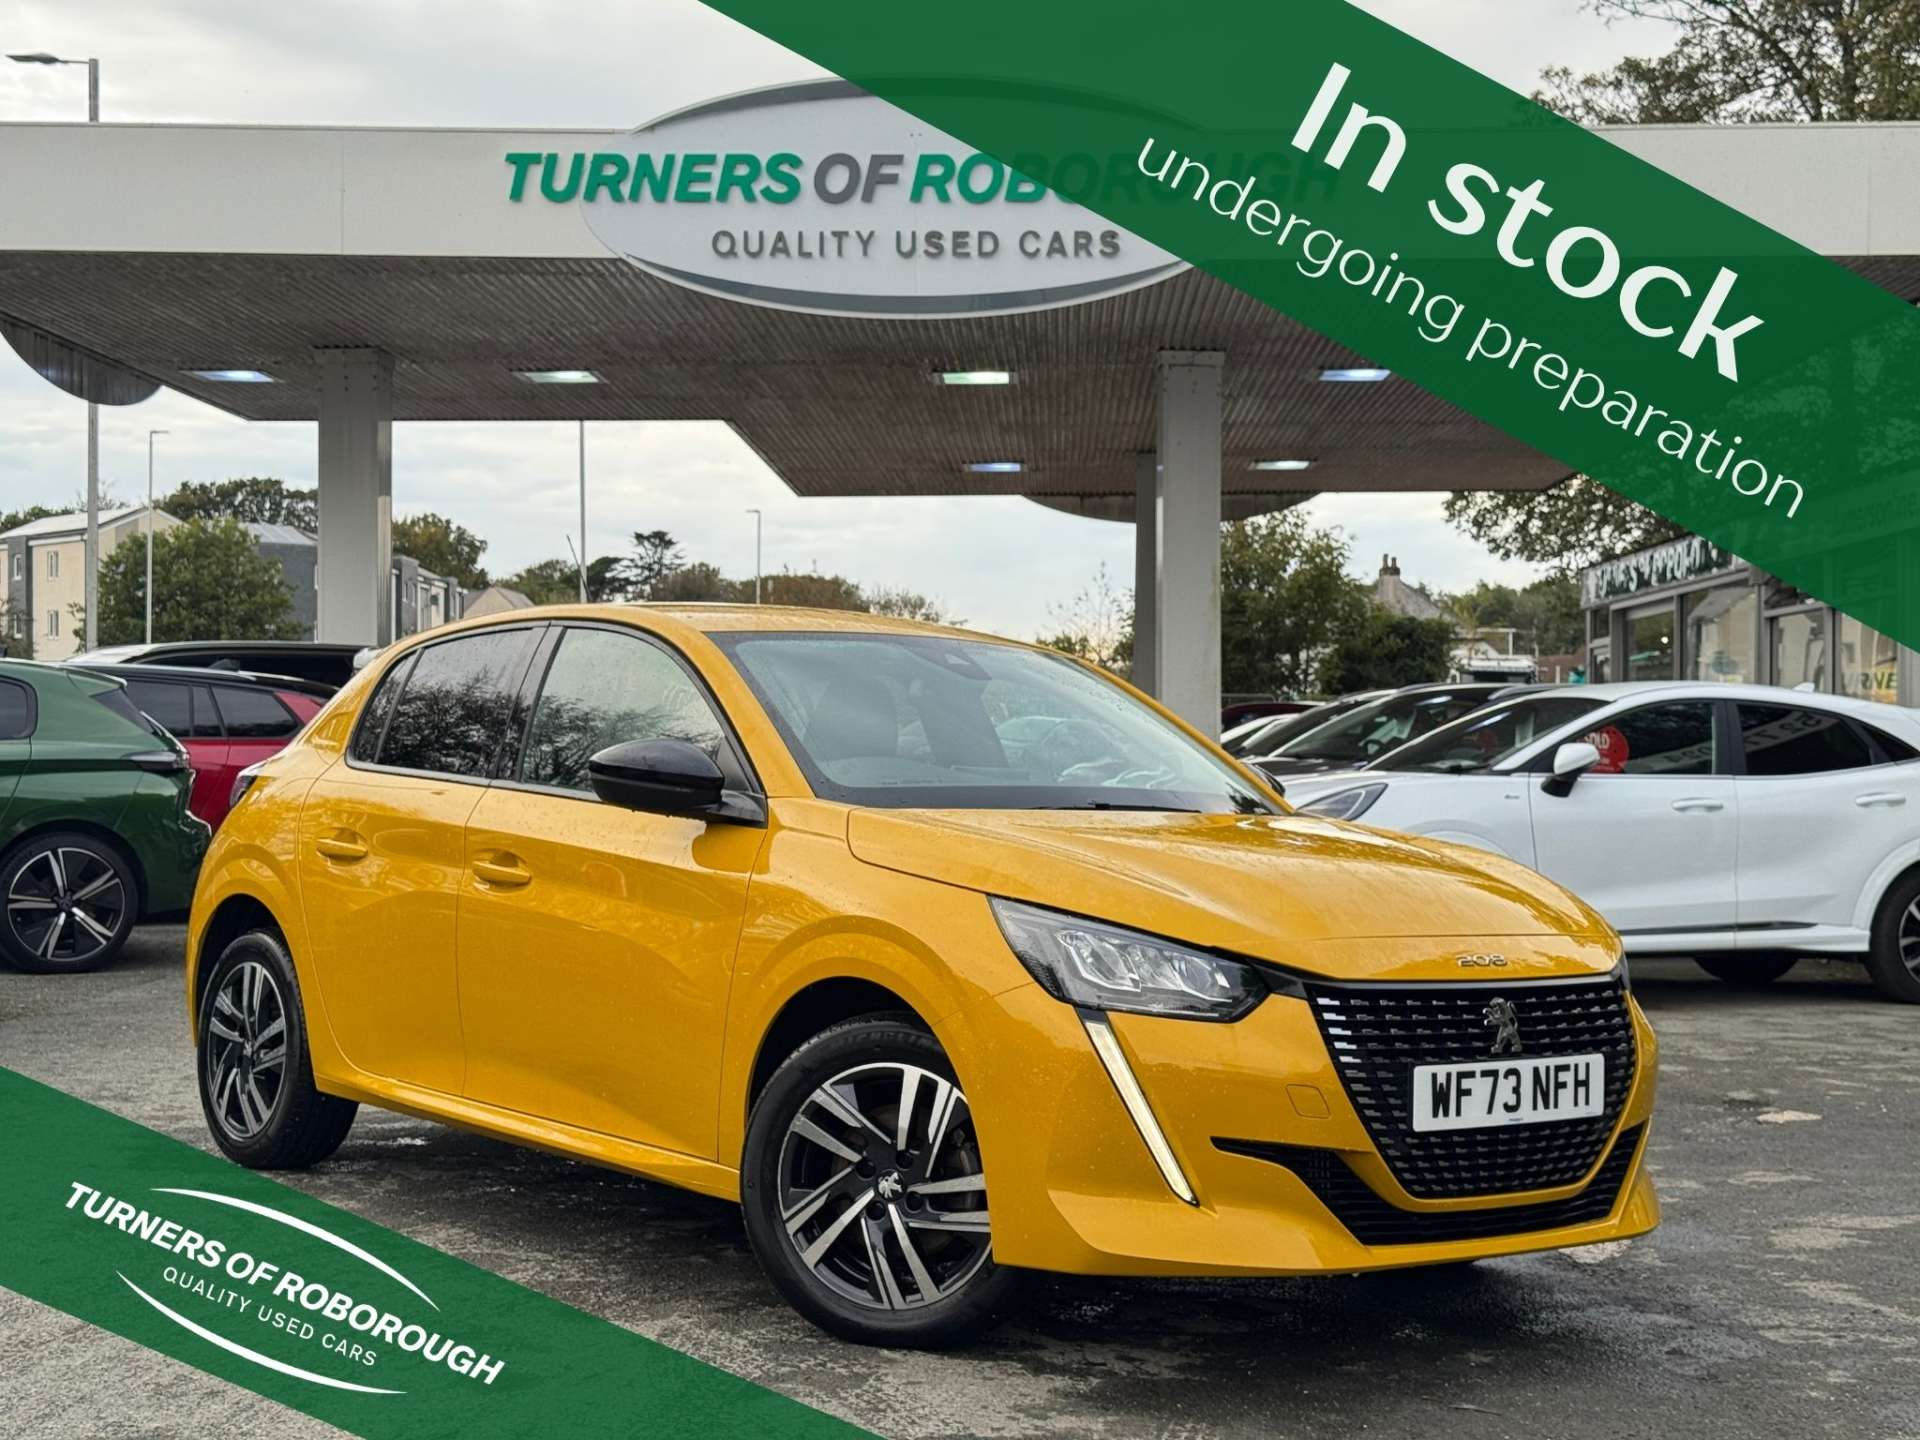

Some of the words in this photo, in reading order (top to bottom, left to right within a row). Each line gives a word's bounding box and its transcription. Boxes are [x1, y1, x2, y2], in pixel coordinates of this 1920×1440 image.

[505, 152, 803, 204] TURNERS
[812, 152, 905, 204] OF
[711, 230, 873, 259] QUALITY
[895, 229, 1000, 258] USED
[1018, 228, 1122, 258] CARS
[1456, 953, 1508, 968] 208
[1431, 1067, 1522, 1119] WF73
[1532, 1062, 1591, 1112] NFH
